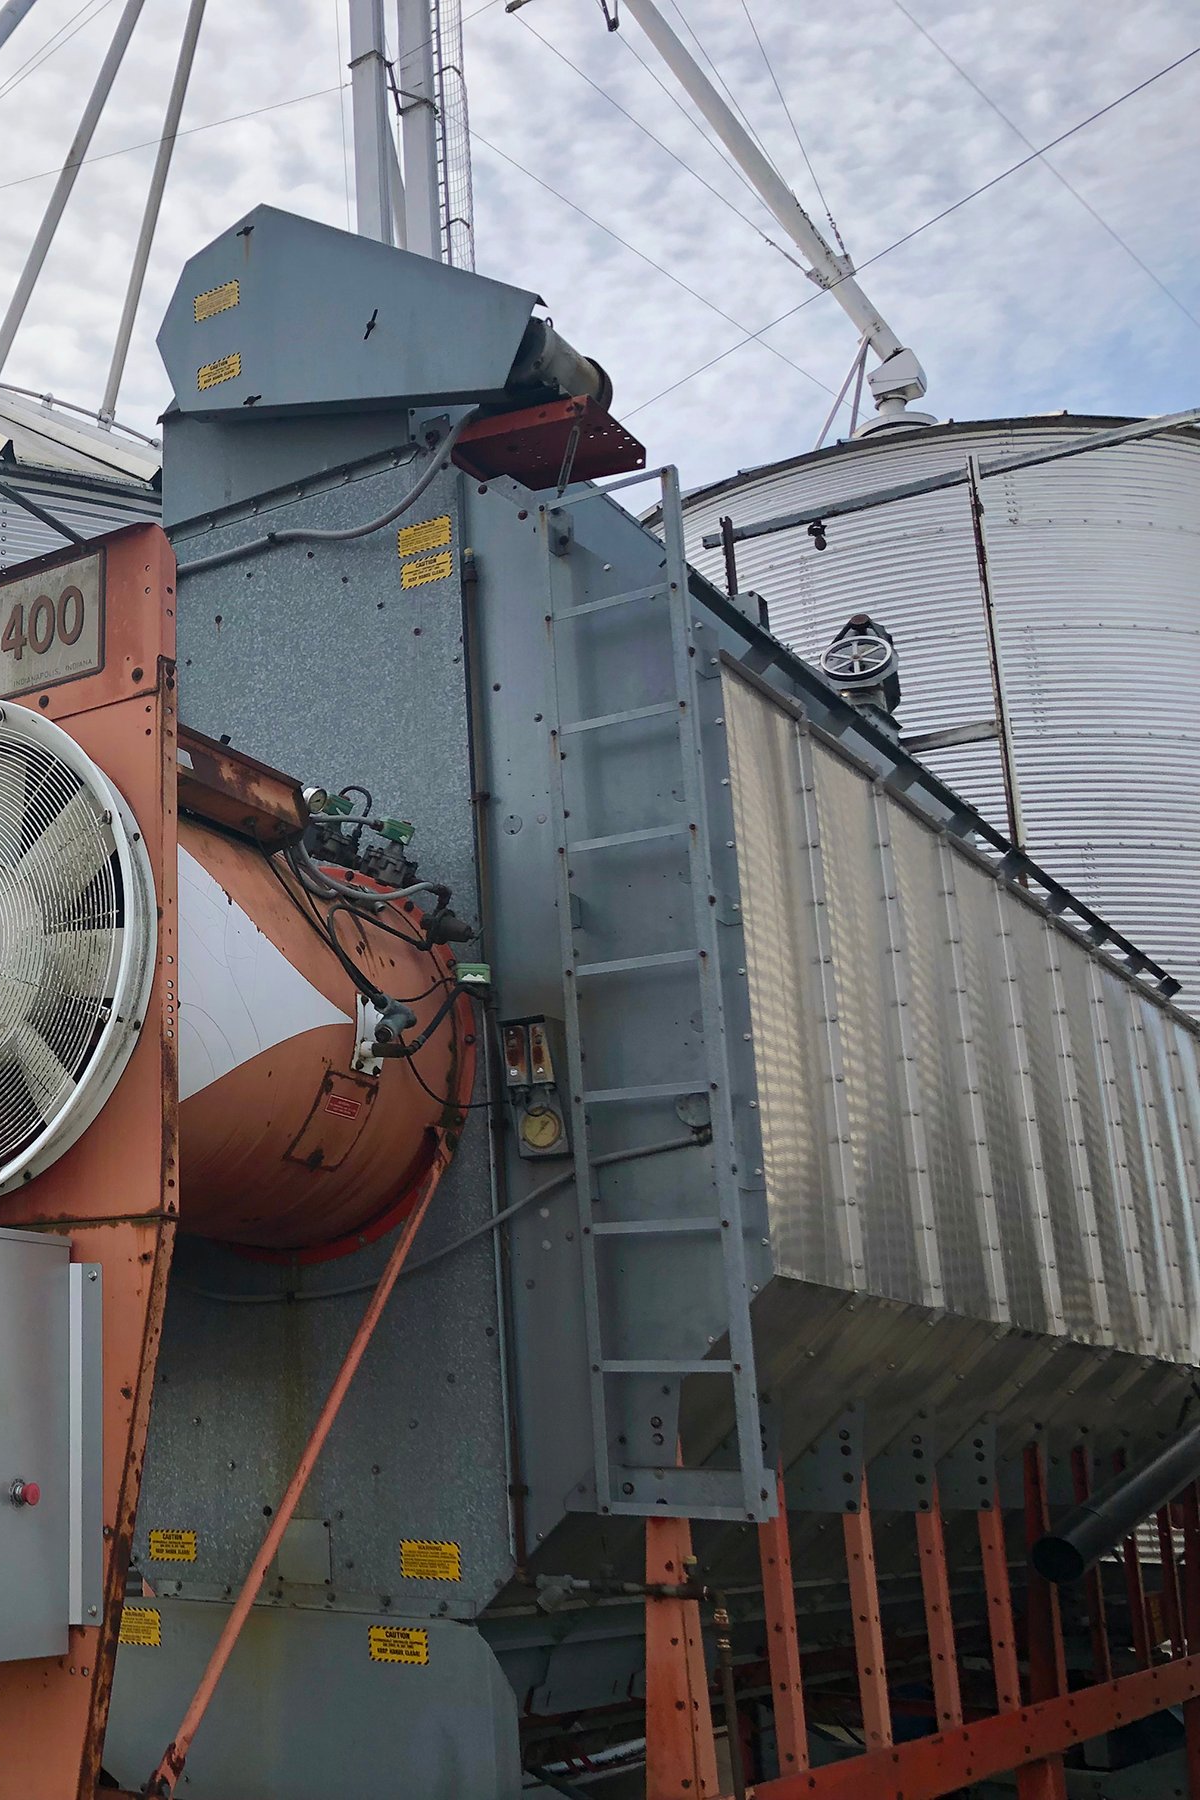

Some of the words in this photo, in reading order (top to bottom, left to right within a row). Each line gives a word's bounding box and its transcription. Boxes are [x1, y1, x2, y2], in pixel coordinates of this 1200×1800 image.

[415, 558, 437, 569] CAUTION
[65, 658, 93, 672] INDIANA
[162, 1533, 183, 1541] CAUTION
[385, 1630, 411, 1640] CAUTION
